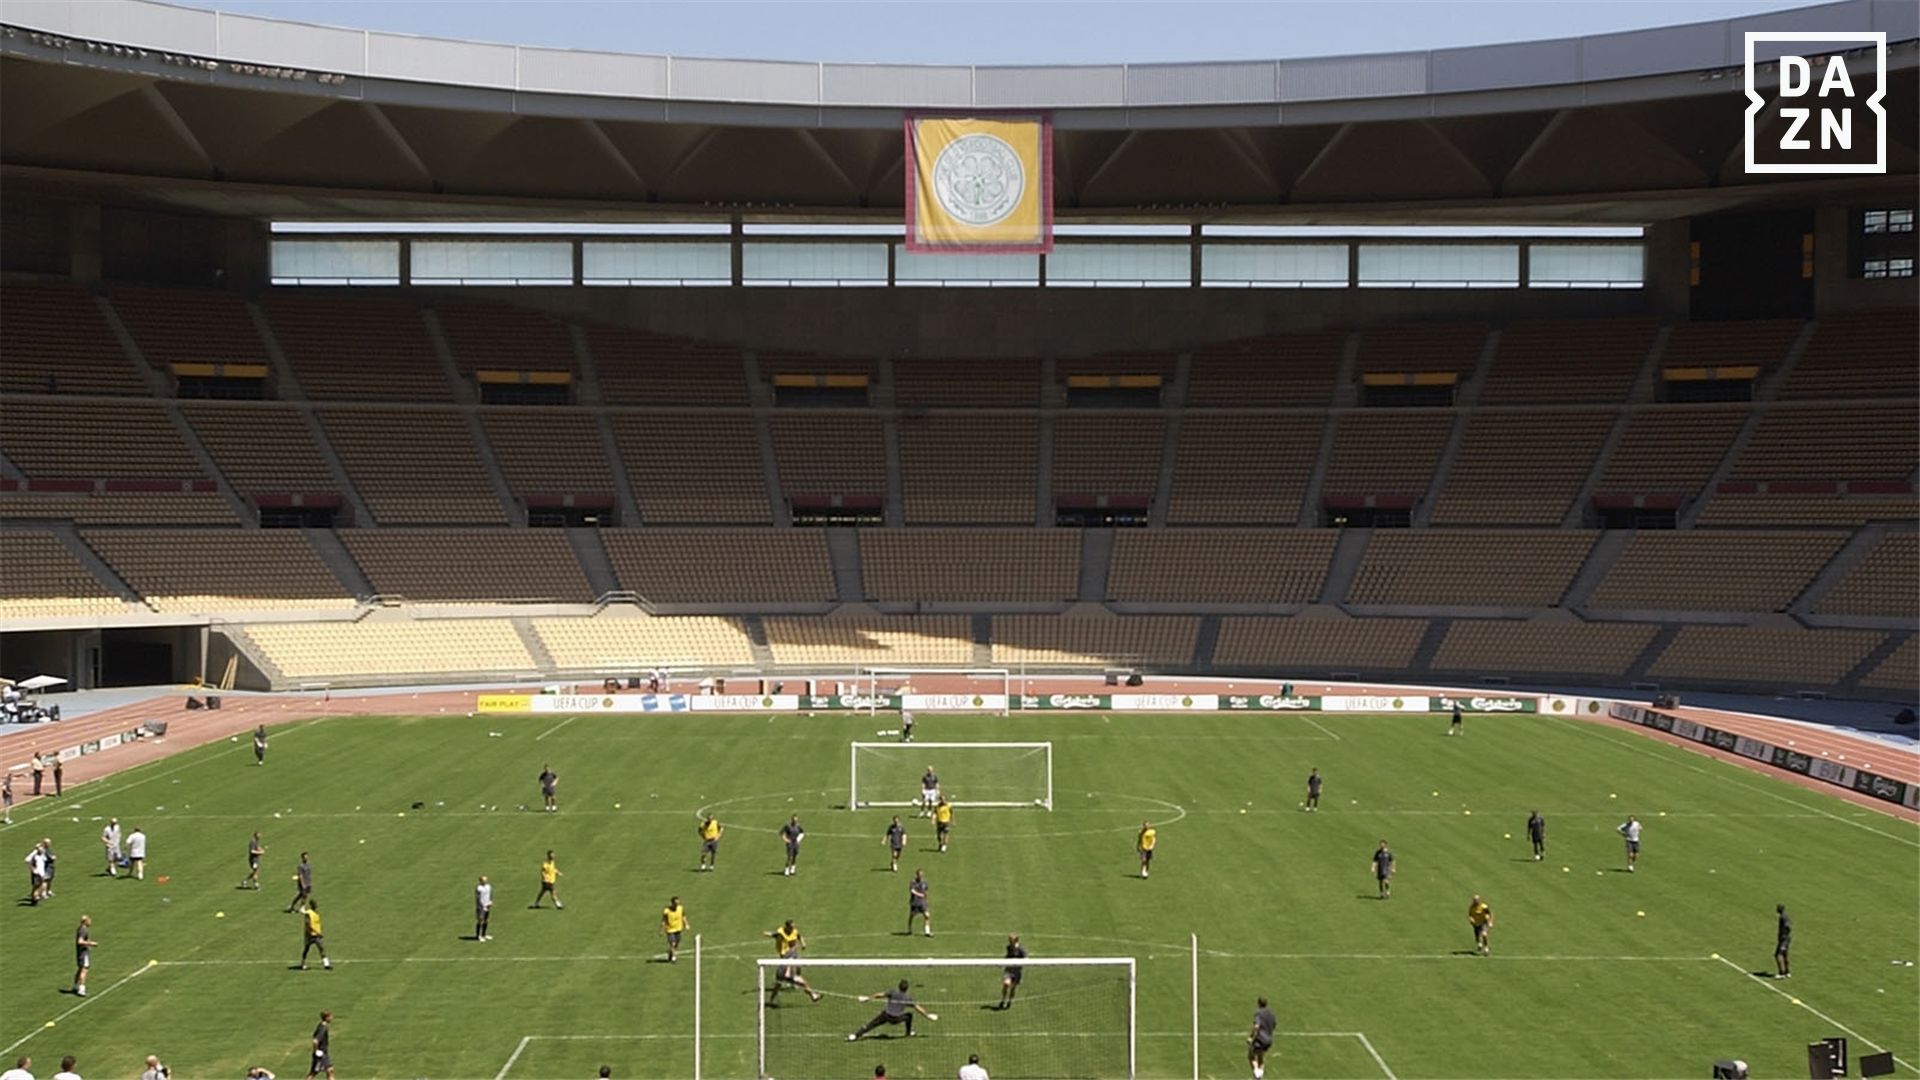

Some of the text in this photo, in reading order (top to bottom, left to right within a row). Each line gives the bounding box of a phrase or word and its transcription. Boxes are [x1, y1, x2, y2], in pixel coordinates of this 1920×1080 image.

[498, 700, 520, 708] PLAY
[553, 697, 599, 710] UEFA CUP
[714, 696, 759, 708] UEFA CUP
[925, 696, 969, 708] UEFA CUP
[1344, 697, 1388, 710] UEFA CUP
